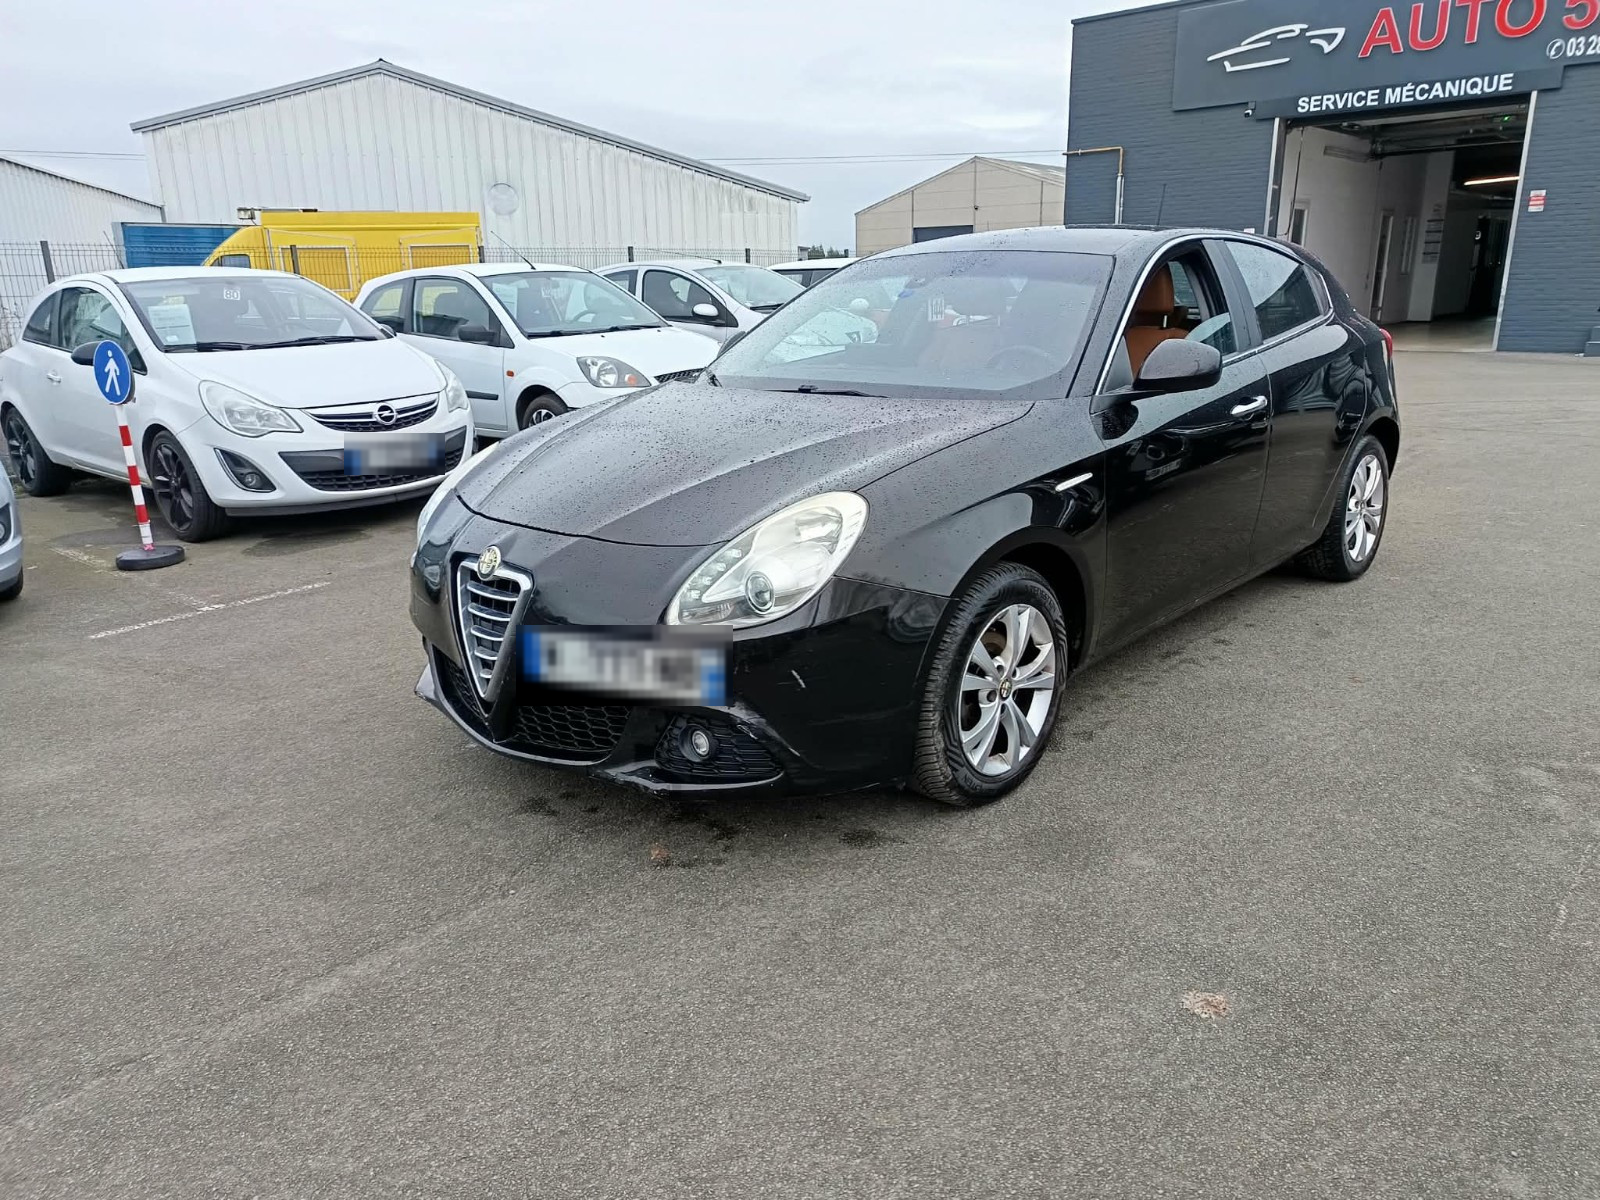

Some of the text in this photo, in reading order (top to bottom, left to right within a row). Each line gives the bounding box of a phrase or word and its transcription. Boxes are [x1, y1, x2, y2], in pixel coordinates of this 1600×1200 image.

[1358, 0, 1548, 58] AUTO
[1566, 36, 1586, 57] 03
[1297, 72, 1514, 113] SERVICE MÉCANIQUE
